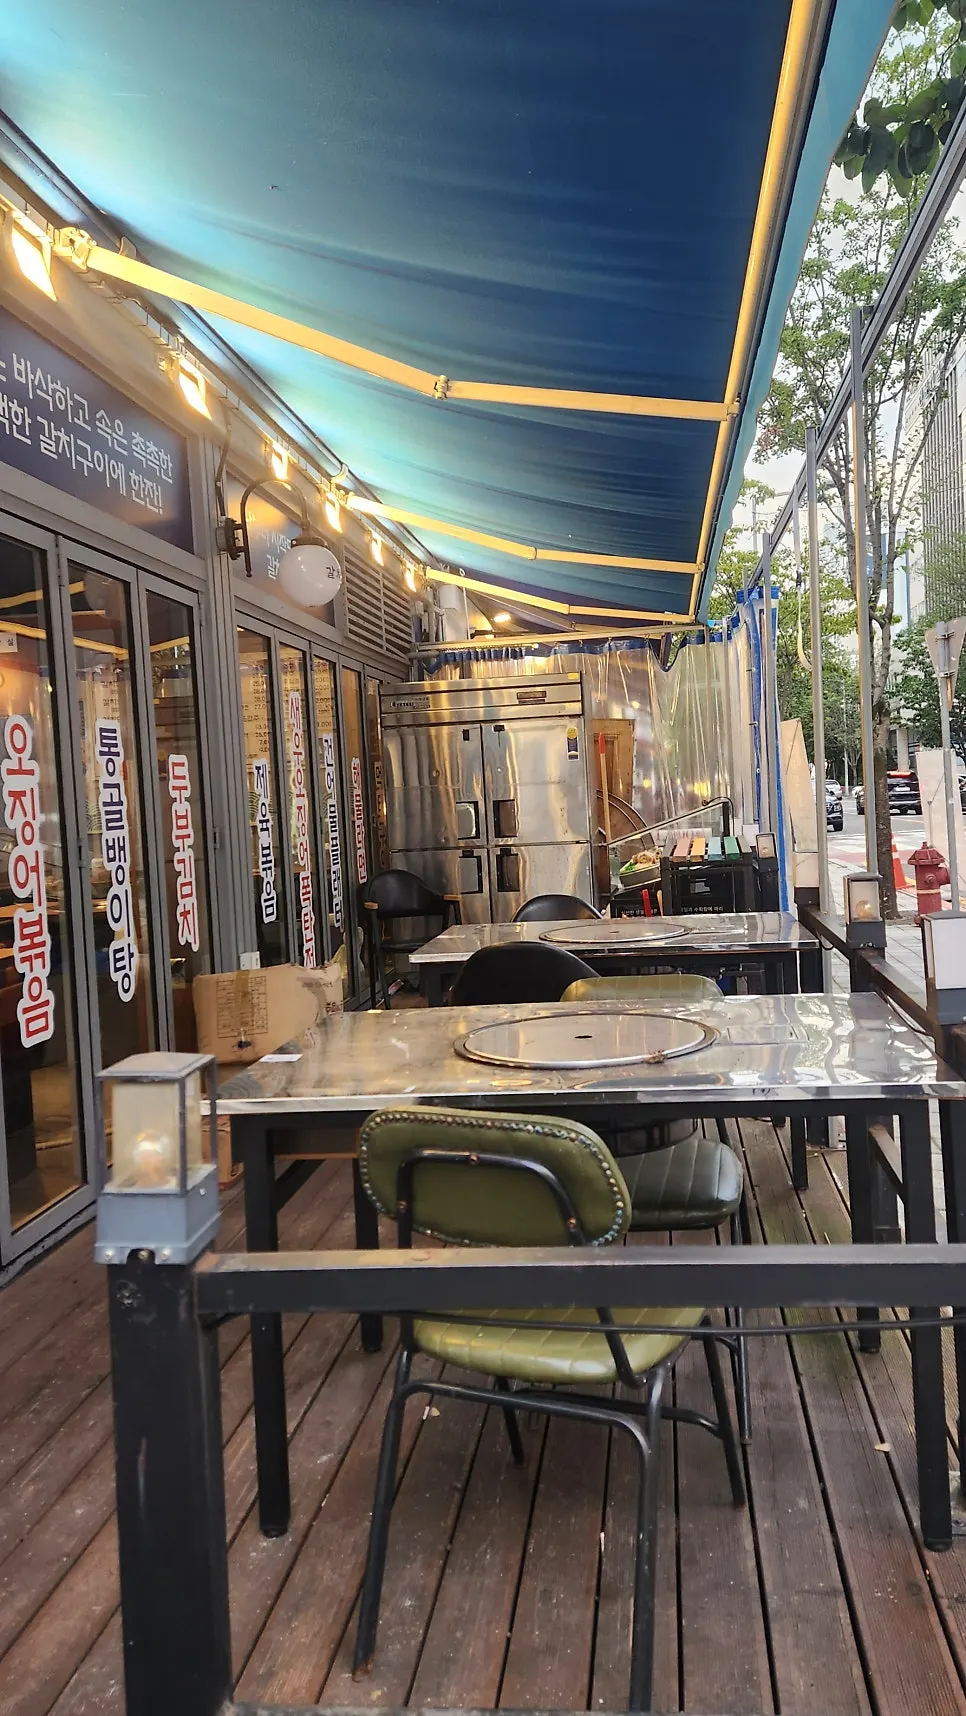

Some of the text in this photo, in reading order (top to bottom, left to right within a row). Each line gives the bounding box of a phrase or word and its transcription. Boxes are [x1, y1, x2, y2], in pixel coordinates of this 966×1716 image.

[12, 353, 173, 484] 바삭하고 속은 촉촉한
[37, 416, 126, 496] 갈치구이에
[129, 469, 163, 514] 한잔!
[6, 722, 51, 1040] 오징어볶음
[98, 727, 135, 994] 통골뱅이탕
[171, 761, 198, 945] 두부김치
[255, 764, 276, 920] 제육볶음
